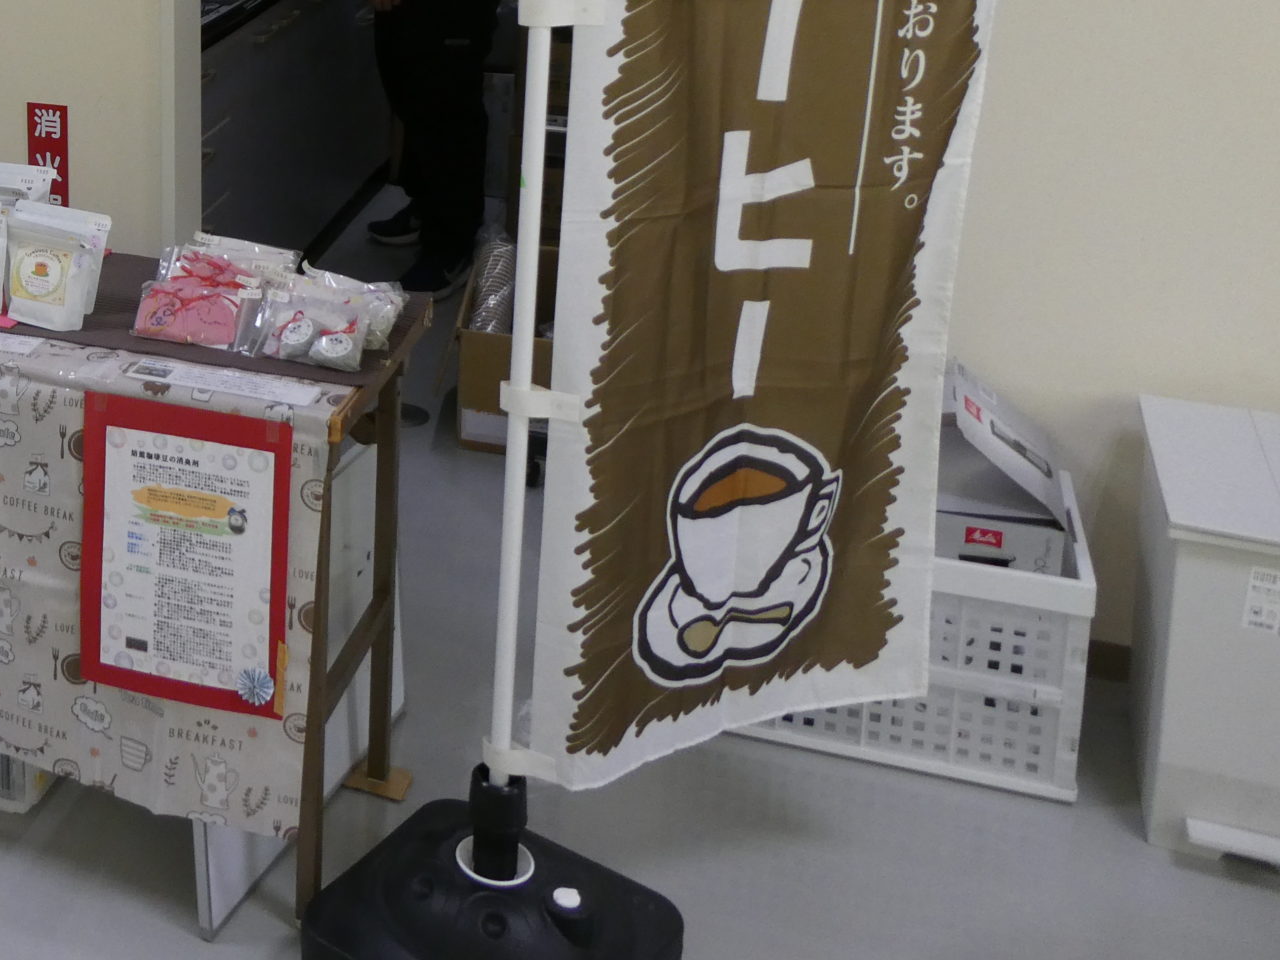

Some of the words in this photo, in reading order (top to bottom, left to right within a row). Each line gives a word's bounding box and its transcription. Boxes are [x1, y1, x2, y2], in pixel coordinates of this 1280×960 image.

[2, 495, 38, 514] COFFEE
[44, 503, 75, 522] BREAK
[54, 623, 76, 635] LOVE
[0, 710, 35, 733] COFFEE
[37, 721, 68, 740] BREAK
[167, 727, 245, 752] BREAKFAST
